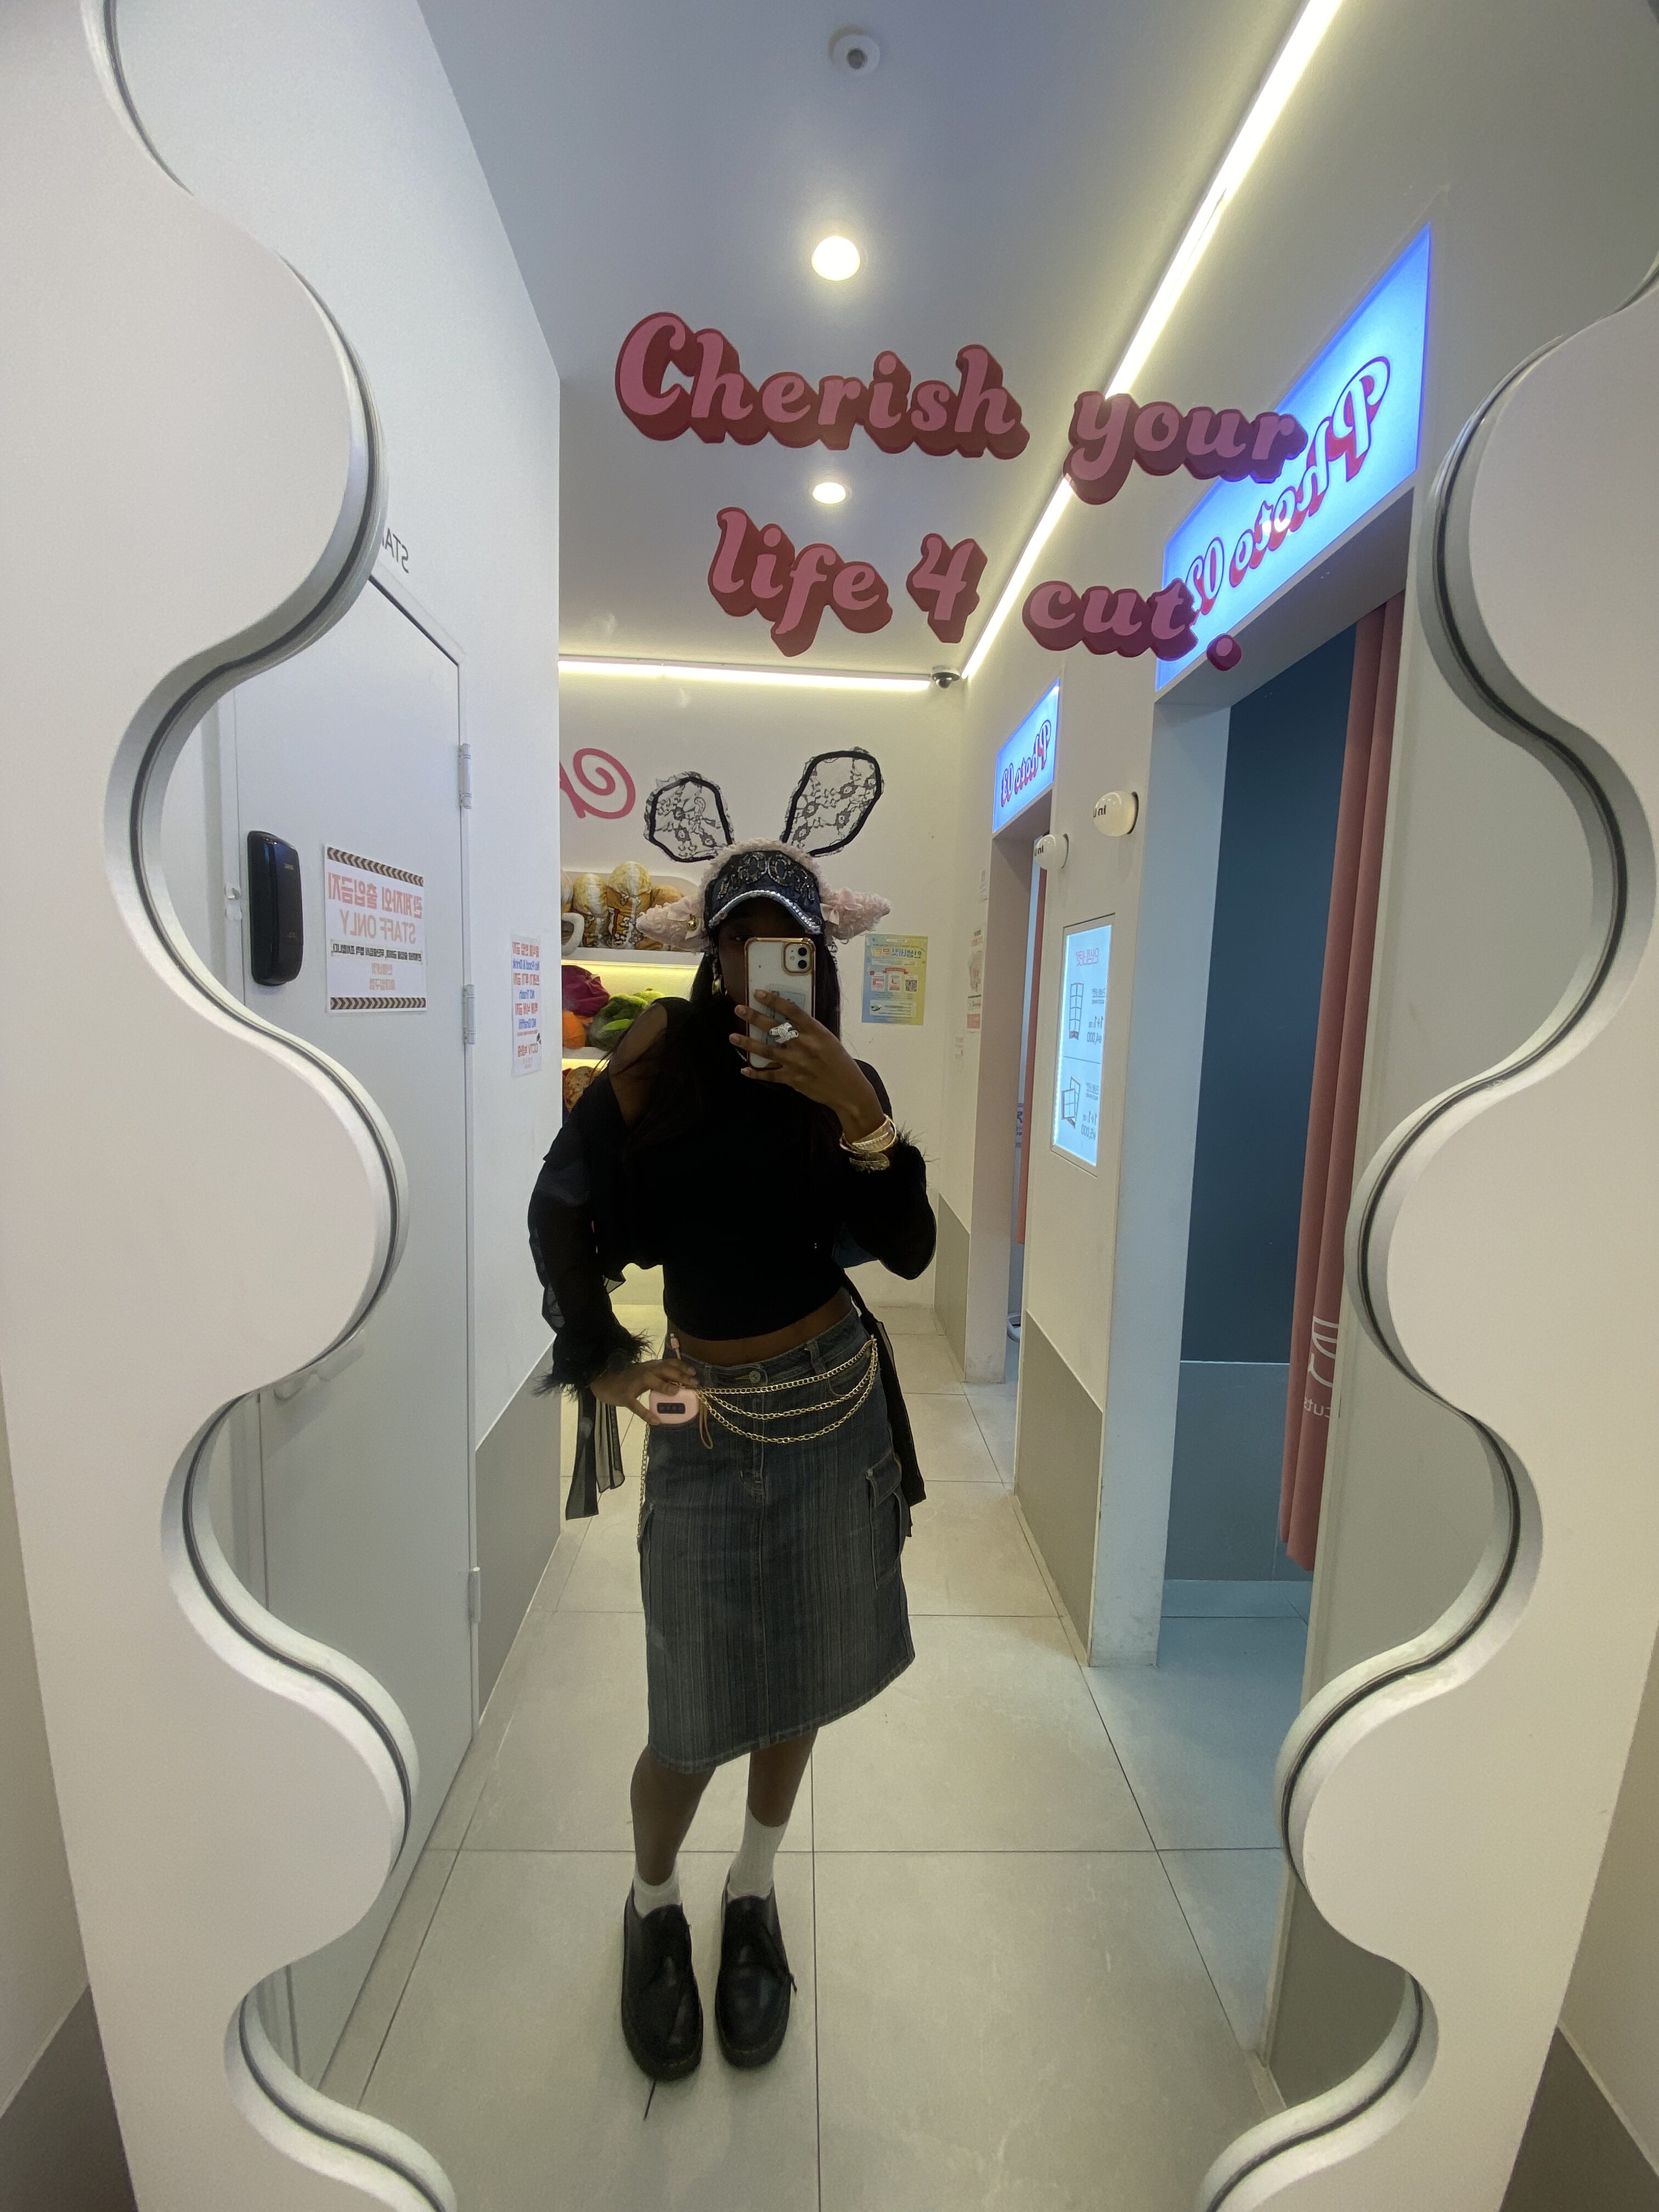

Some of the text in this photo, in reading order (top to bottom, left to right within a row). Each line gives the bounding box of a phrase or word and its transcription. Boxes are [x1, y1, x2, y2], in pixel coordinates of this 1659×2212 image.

[615, 312, 1308, 505] Cherish your
[707, 506, 1242, 671] life 4 cut.
